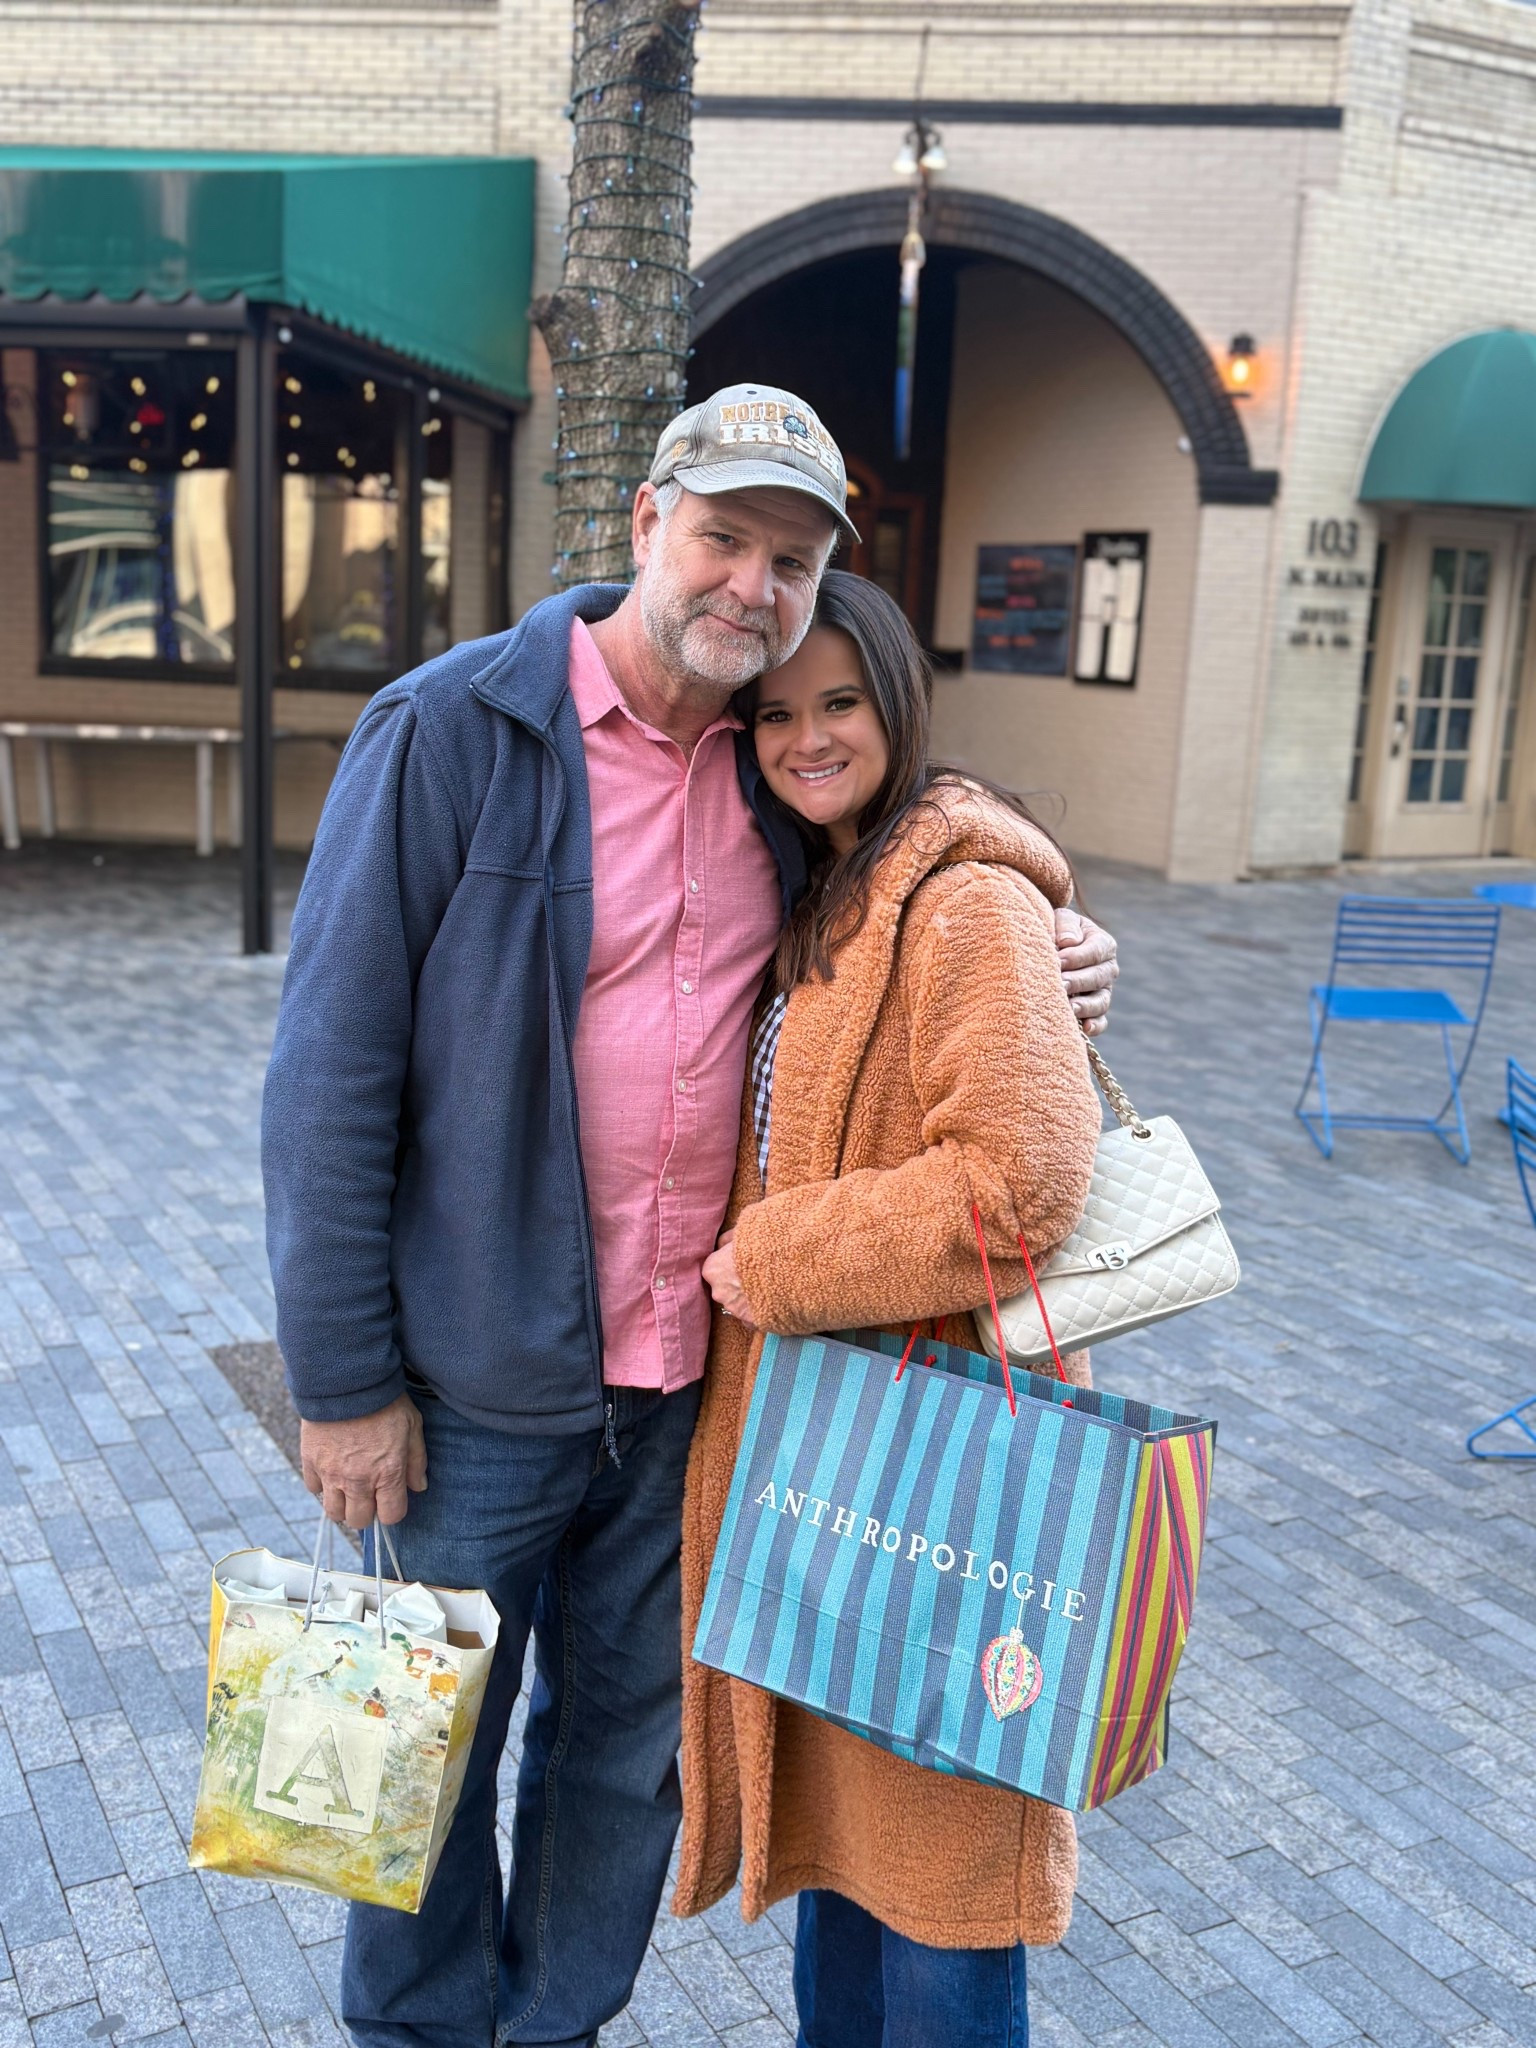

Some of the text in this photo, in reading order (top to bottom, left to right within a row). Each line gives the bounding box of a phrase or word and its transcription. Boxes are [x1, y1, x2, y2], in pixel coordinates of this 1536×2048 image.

[719, 401, 792, 424] NOTRE
[719, 424, 842, 484] IRISH
[1307, 518, 1359, 558] 103
[754, 1481, 1087, 1622] ANTHROPOLOGIE
[265, 1723, 365, 1818] A
